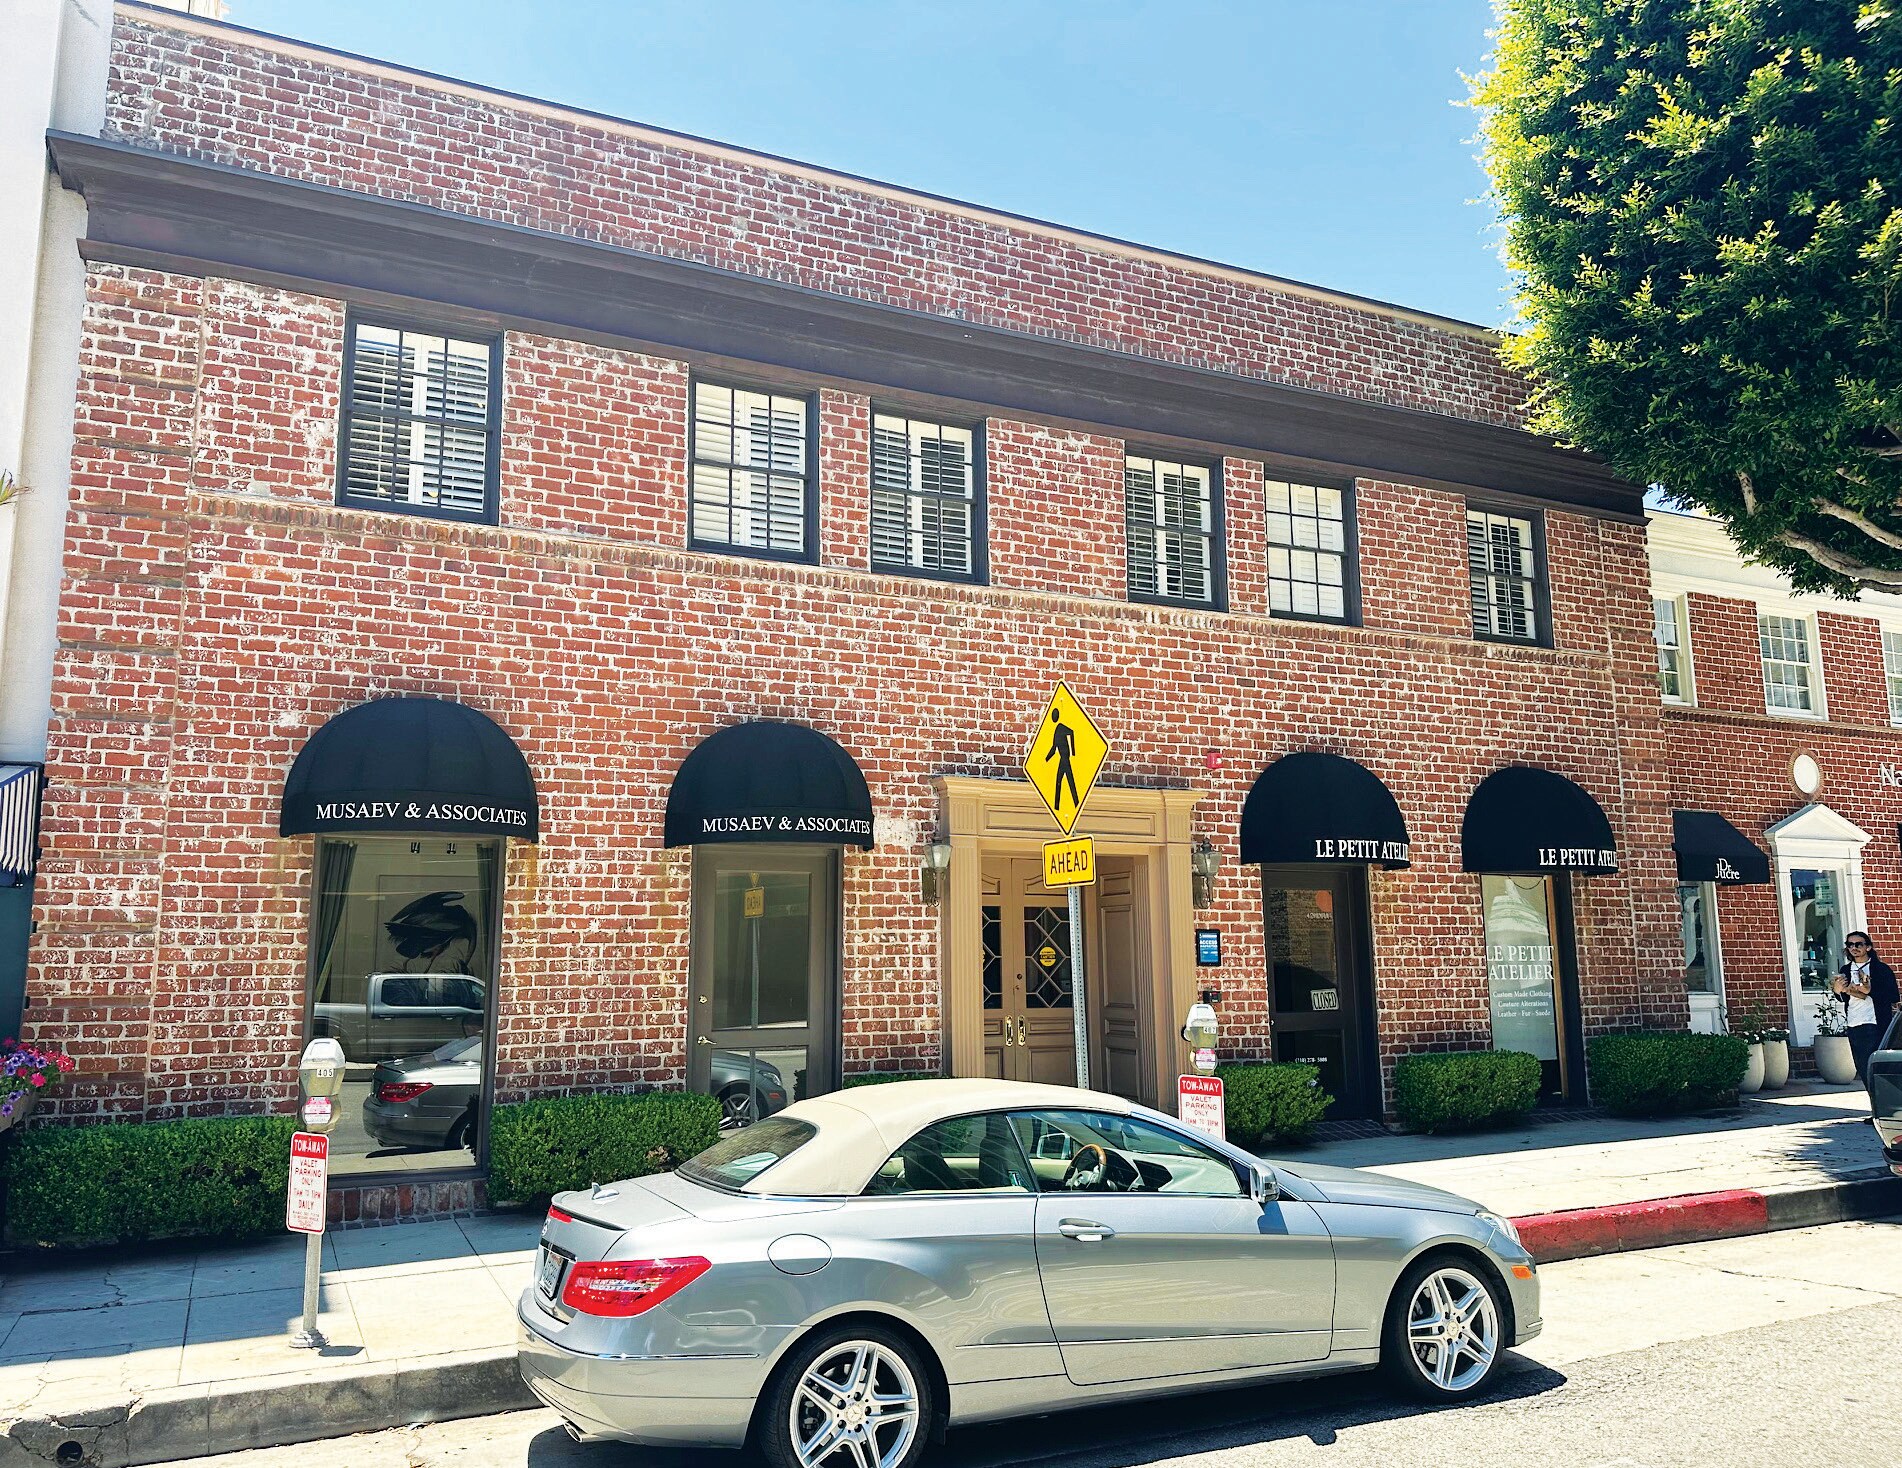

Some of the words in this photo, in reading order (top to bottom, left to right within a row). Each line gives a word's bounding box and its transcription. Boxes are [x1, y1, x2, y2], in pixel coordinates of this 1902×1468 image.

[315, 802, 400, 820] MUSAEV
[404, 802, 421, 818] &
[425, 804, 527, 826] ASSOCIATES
[702, 816, 776, 832] MUSAEV
[778, 816, 793, 831] &
[795, 817, 871, 835] ASSOCIATES
[1315, 839, 1335, 858] LE
[1337, 839, 1379, 859] PETIT
[1050, 850, 1088, 875] AHEAD
[1539, 848, 1558, 866] LE
[1559, 848, 1596, 866] PETIT
[1597, 849, 1618, 867] ATELI
[1714, 863, 1740, 880] Jucre
[1486, 945, 1504, 962] LE
[1507, 945, 1555, 962] PETIT
[1488, 964, 1555, 980] ATELIER
[1529, 990, 1553, 999] Clothing
[1497, 1010, 1517, 1018] Leather
[1535, 1009, 1551, 1017] Suede
[317, 1069, 333, 1077] 405
[1181, 1080, 1220, 1092] TOW-AWAY
[1190, 1095, 1212, 1103] VALET
[1185, 1101, 1217, 1111] PARKING
[294, 1139, 326, 1154] TOW-AWAY
[300, 1159, 318, 1168] VALET
[295, 1167, 322, 1178] PARKING
[298, 1199, 315, 1210] DAILY
